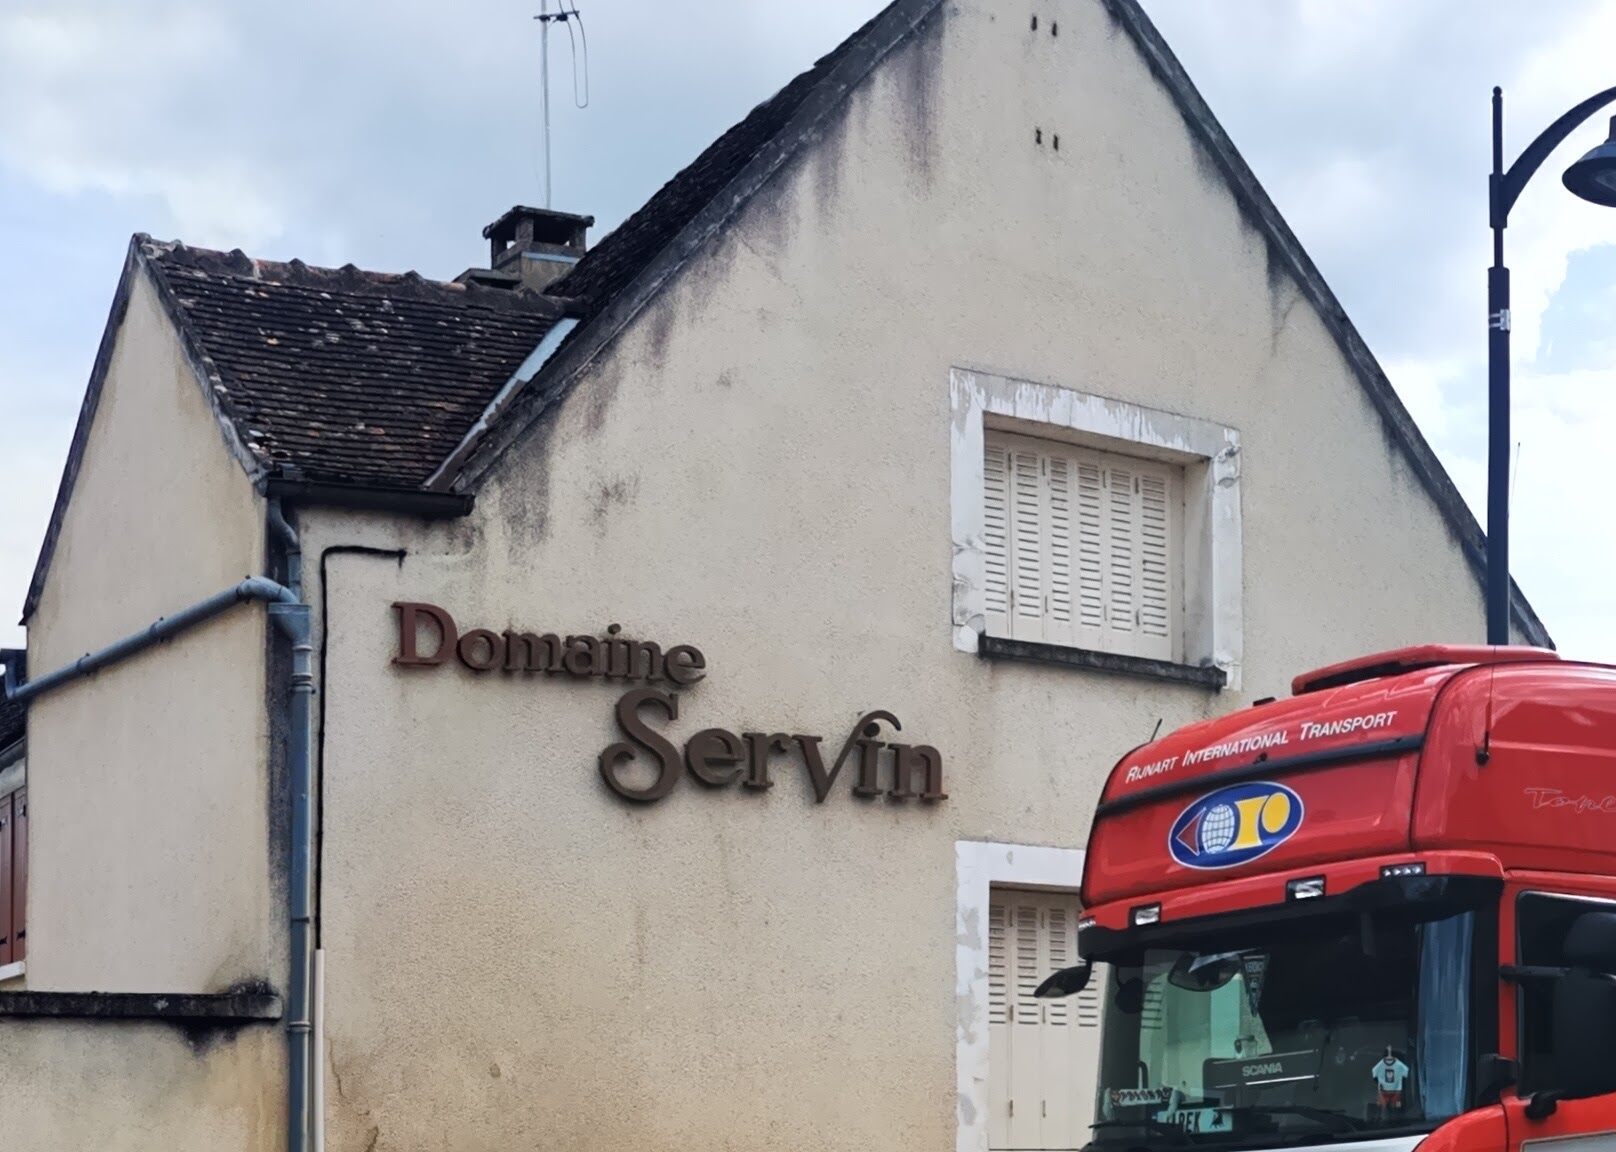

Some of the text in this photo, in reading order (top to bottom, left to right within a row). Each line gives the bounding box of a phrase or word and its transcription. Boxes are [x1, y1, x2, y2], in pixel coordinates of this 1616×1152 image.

[391, 601, 706, 685] Domaine
[597, 688, 949, 803] Servin
[1126, 711, 1397, 783] RIJNART INTERNATIONAL TRANSPORT
[1242, 1061, 1283, 1077] SCANIA
